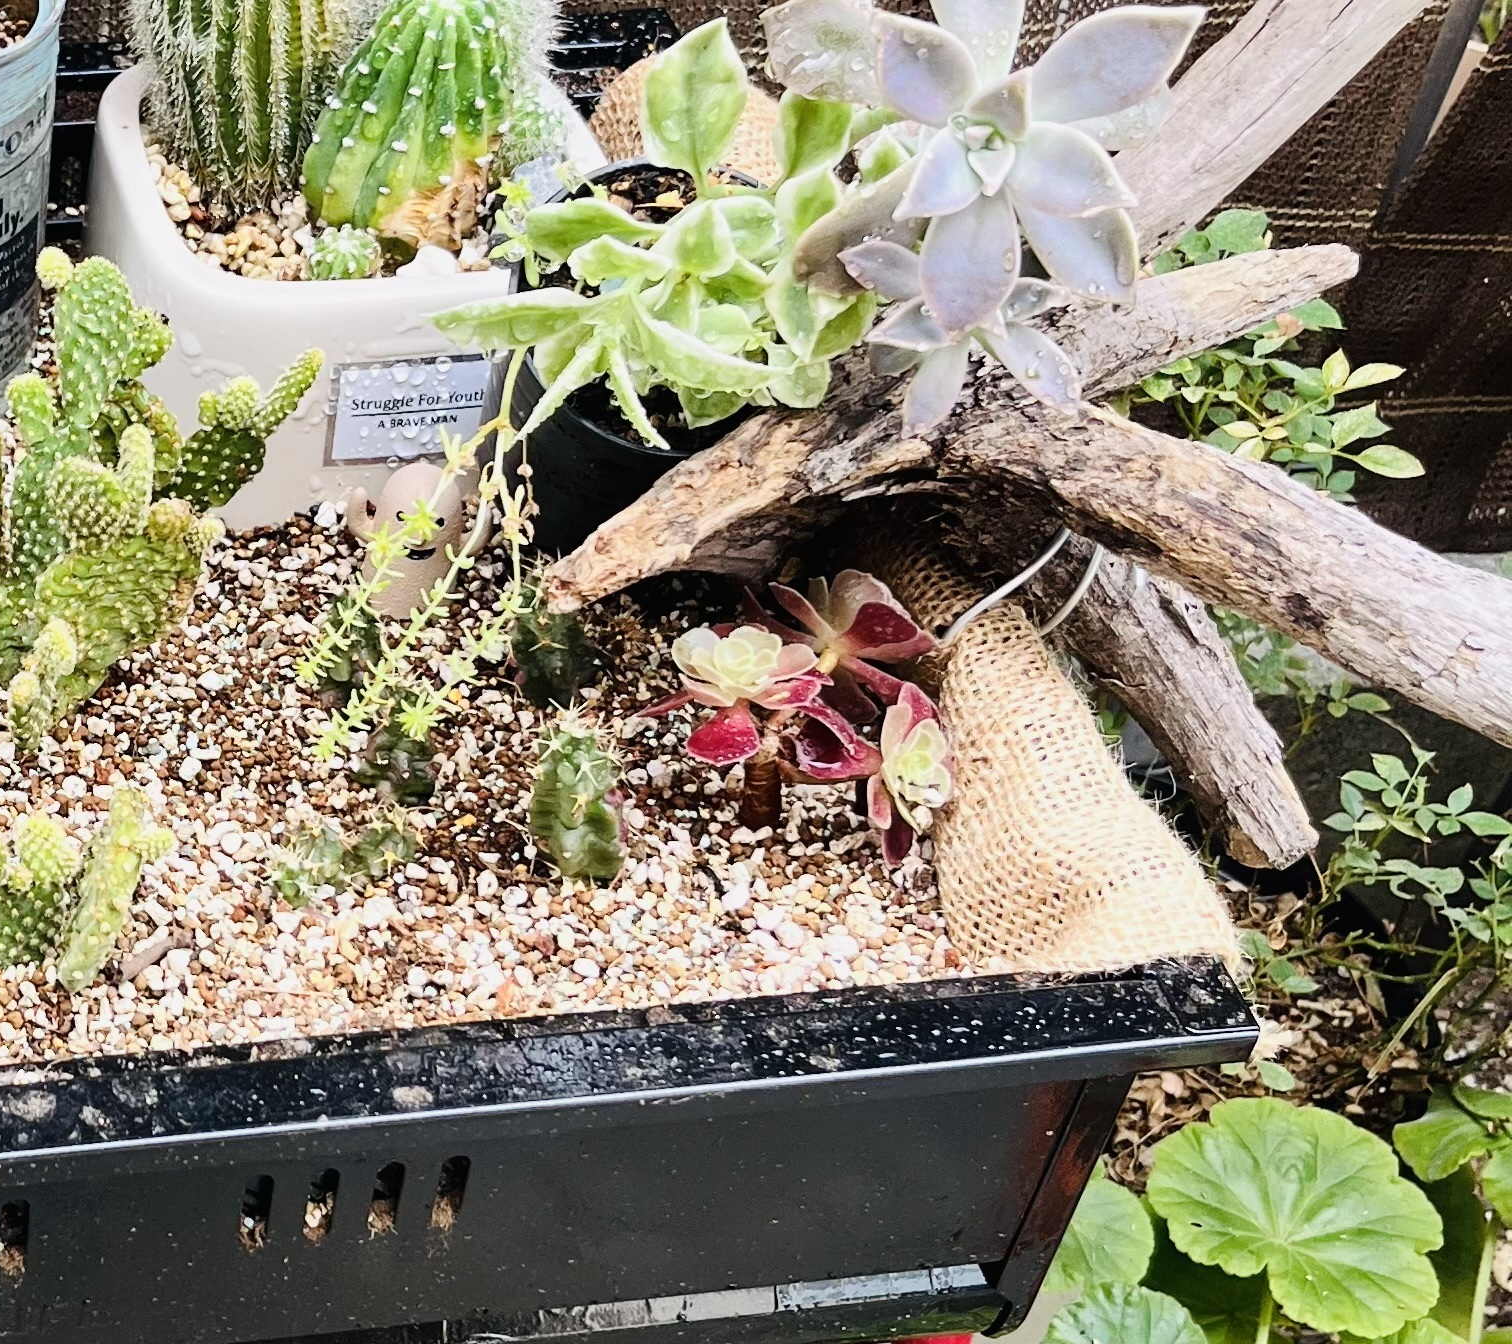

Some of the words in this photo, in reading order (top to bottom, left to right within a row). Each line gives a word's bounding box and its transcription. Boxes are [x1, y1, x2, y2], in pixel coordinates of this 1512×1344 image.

[0, 276, 10, 291] of
[351, 397, 414, 412] Struggle
[418, 393, 442, 407] For
[377, 420, 386, 429] A
[390, 416, 426, 429] BRAVE
[431, 414, 458, 426] MAN
